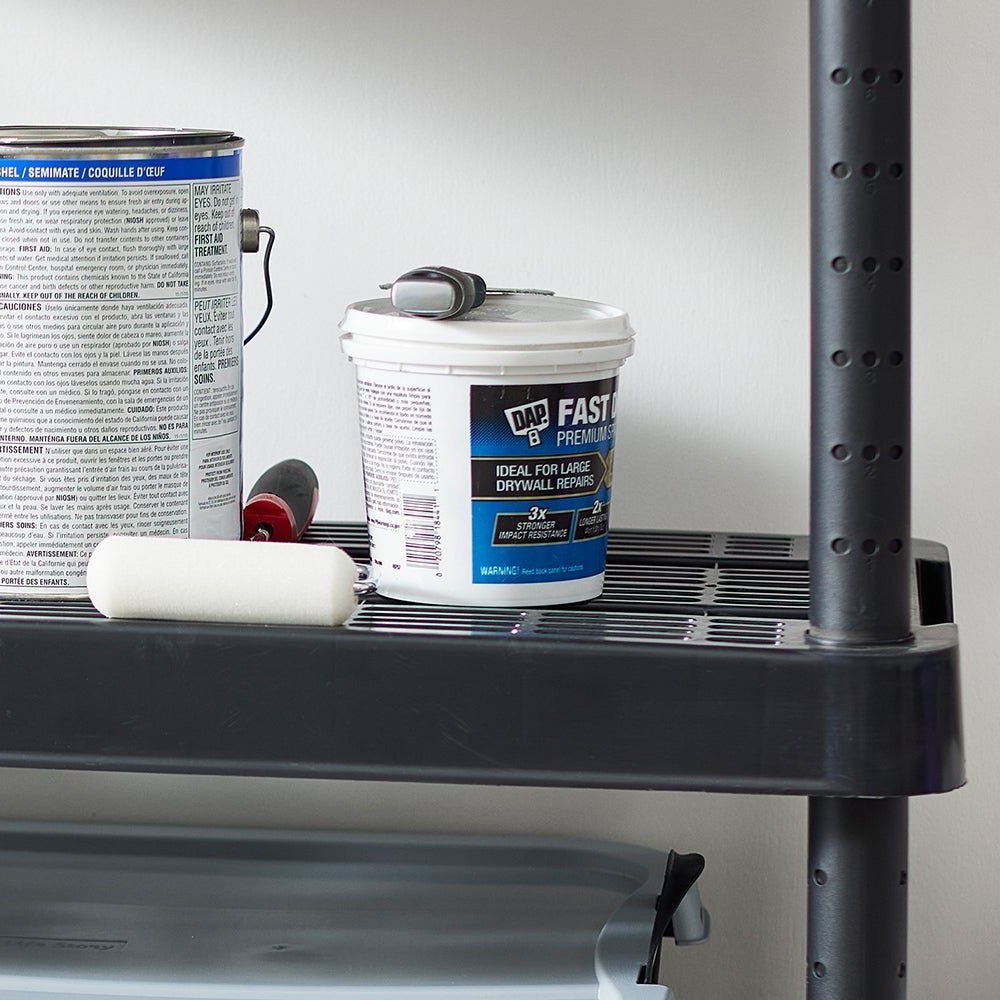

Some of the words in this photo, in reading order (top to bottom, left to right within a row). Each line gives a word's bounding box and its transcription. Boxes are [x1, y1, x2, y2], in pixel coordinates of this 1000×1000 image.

[28, 166, 80, 179] SEMIMATE
[88, 166, 135, 178] COQUILLE
[137, 165, 165, 178] D'ŒUF
[62, 190, 88, 198] adequate
[195, 185, 209, 196] MAY
[195, 197, 212, 208] EYES.
[214, 197, 221, 207] Do
[194, 212, 210, 223] eyes.
[211, 209, 225, 221] Keep
[195, 222, 211, 233] reach
[195, 234, 212, 245] FIRST
[214, 233, 223, 243] AID
[195, 245, 228, 257] TREATMENT.
[195, 300, 210, 311] PEUT
[194, 312, 213, 324] YEUX.
[195, 326, 215, 336] contact
[194, 351, 202, 360] de
[204, 349, 209, 359] la
[194, 373, 215, 385] SOINS.
[558, 394, 610, 427] FAST
[29, 434, 65, 442] MANTÉNGA
[557, 427, 607, 447] PREMIUM
[496, 465, 532, 477] IDEAL
[535, 464, 558, 476] FOR
[561, 460, 591, 474] LARGE
[496, 479, 554, 492] DRYWALL
[556, 474, 594, 490] REPAIRS
[528, 506, 547, 520] 3x
[516, 521, 555, 531] STRONGER
[499, 531, 527, 540] IMPACT
[528, 529, 568, 539] RESISTANCE
[480, 566, 519, 576] WARNING!
[1, 577, 24, 585] PORTÉE
